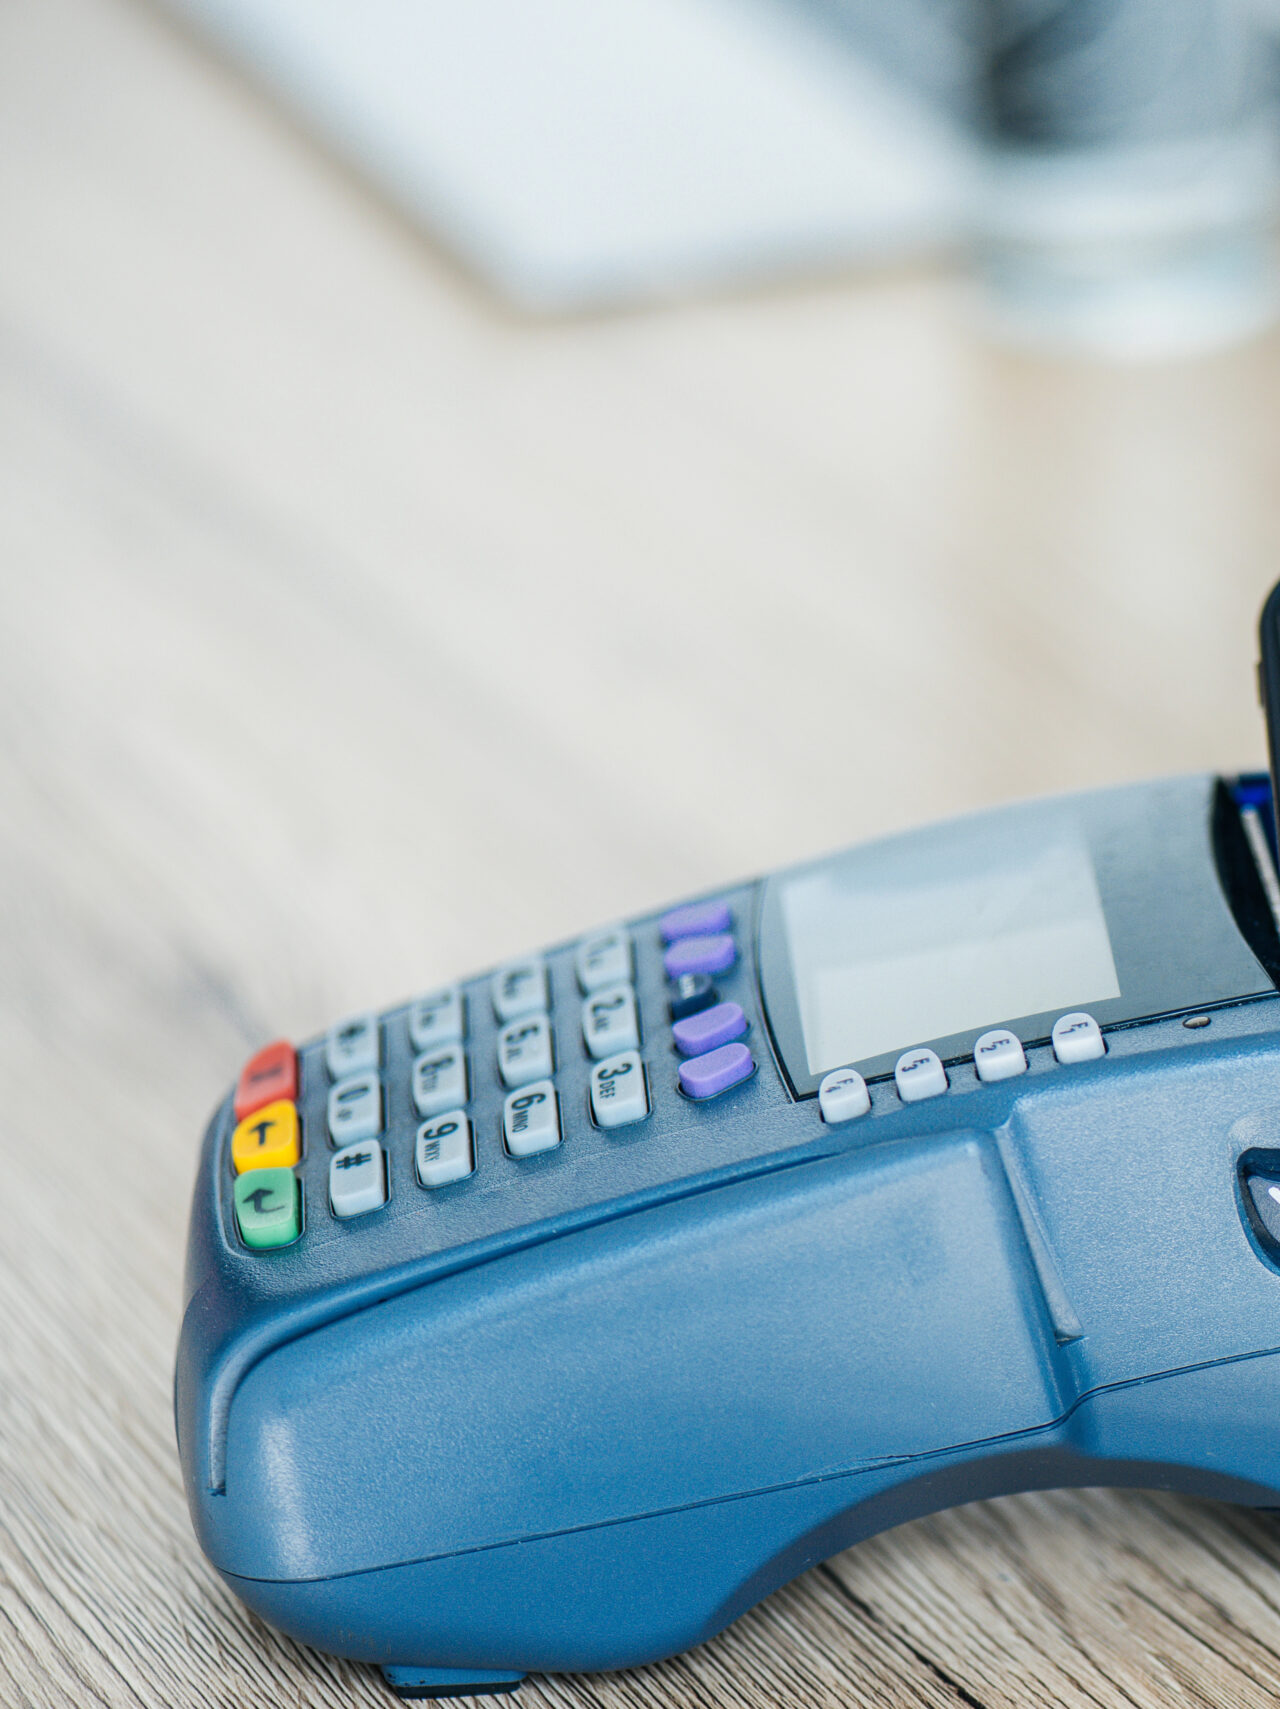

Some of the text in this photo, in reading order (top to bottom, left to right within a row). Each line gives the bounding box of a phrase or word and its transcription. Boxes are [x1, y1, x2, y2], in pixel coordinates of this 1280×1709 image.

[505, 1023, 539, 1044] 5
[1058, 1021, 1088, 1035] F1
[980, 1038, 1010, 1053] F2
[419, 1055, 455, 1075] 8
[597, 1062, 633, 1081] 3
[901, 1057, 930, 1072] F3
[598, 1080, 616, 1099] DEF
[511, 1092, 547, 1133] 6 MNO
[423, 1121, 459, 1163] 9 WXY
